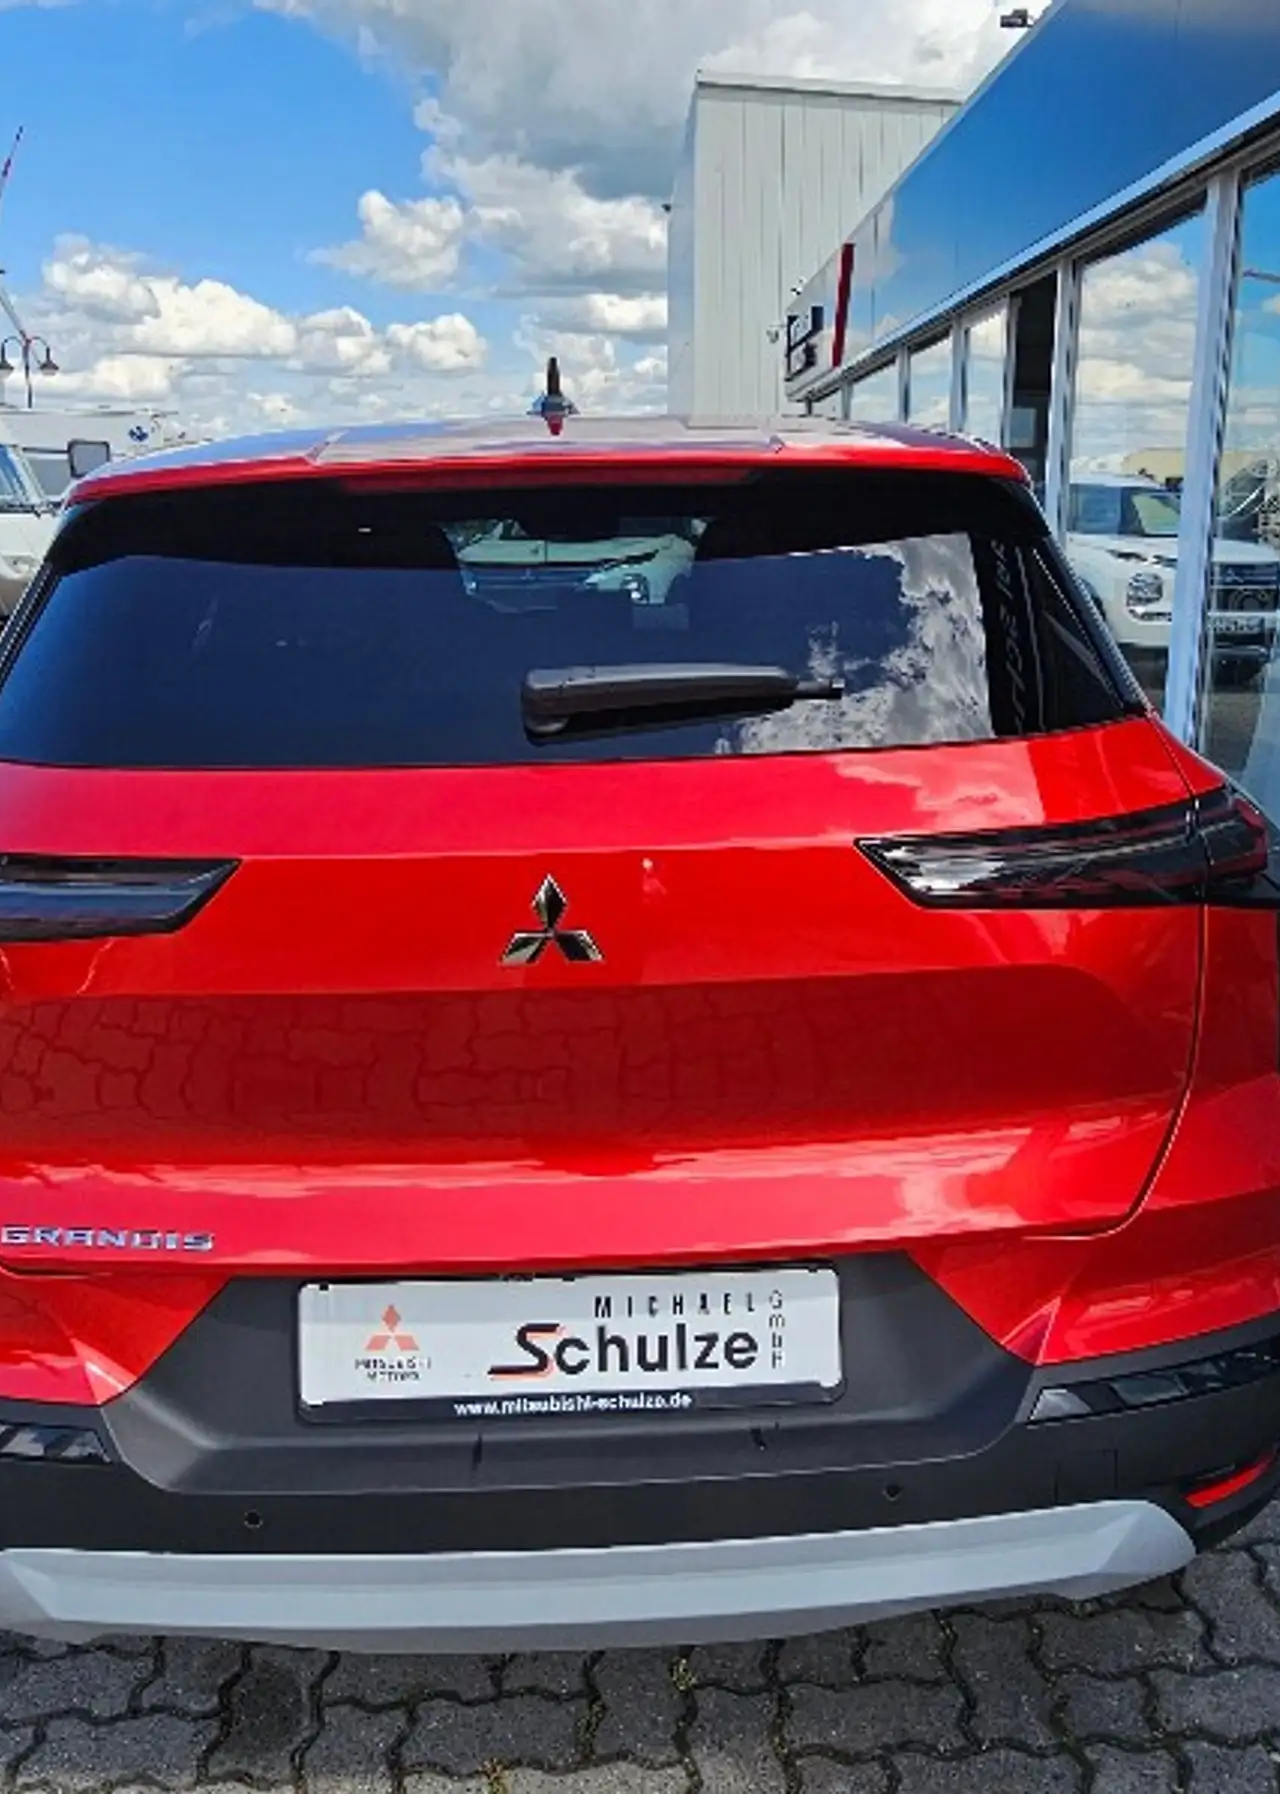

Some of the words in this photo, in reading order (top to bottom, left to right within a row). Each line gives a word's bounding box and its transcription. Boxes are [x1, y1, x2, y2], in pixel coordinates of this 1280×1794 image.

[0, 1225, 213, 1251] GRANDIS
[594, 1293, 756, 1319] MICHAEL
[487, 1323, 759, 1380] Schulze
[453, 1392, 692, 1416] www.mitsubishi-schulze.de
